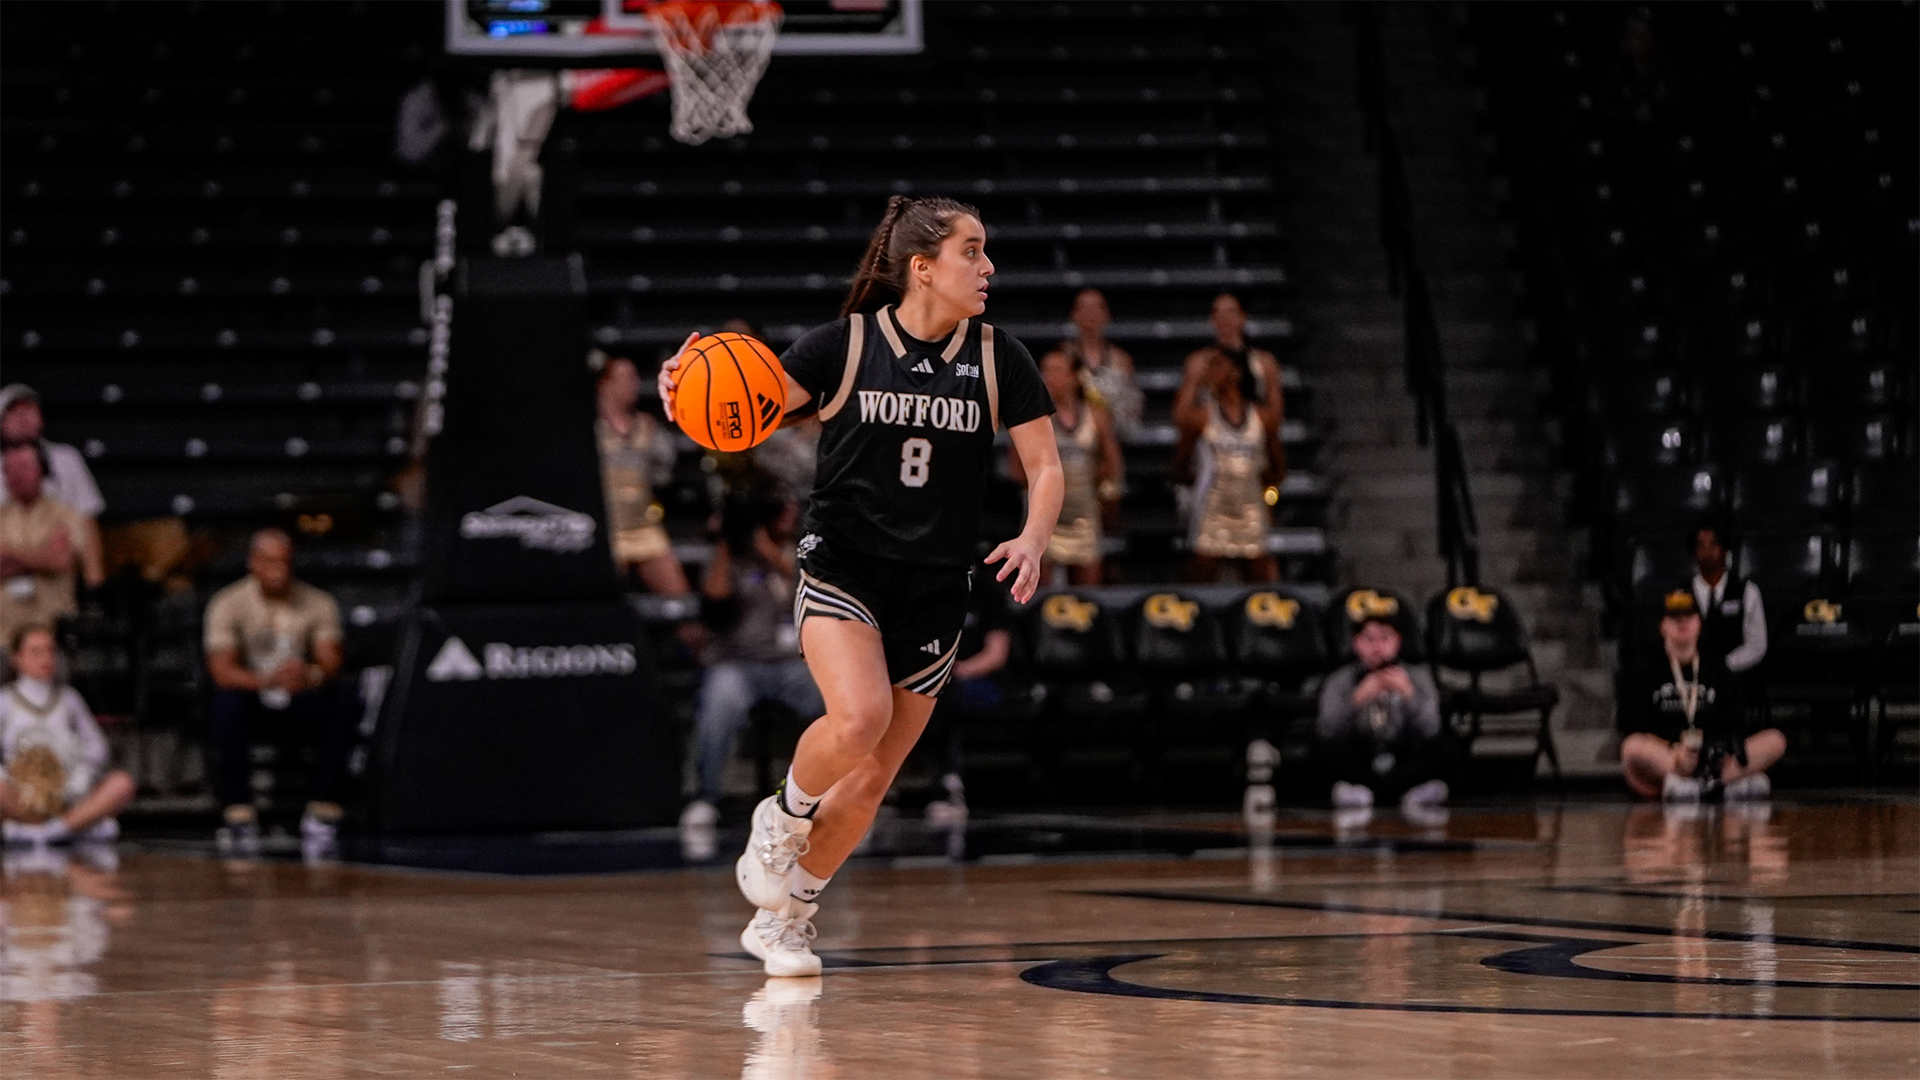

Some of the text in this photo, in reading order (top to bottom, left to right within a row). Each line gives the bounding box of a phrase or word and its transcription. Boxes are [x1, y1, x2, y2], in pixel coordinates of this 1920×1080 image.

[727, 402, 743, 439] PRO
[858, 390, 981, 433] WOFFORD
[900, 437, 933, 488] 8
[485, 643, 635, 678] REGIONS
